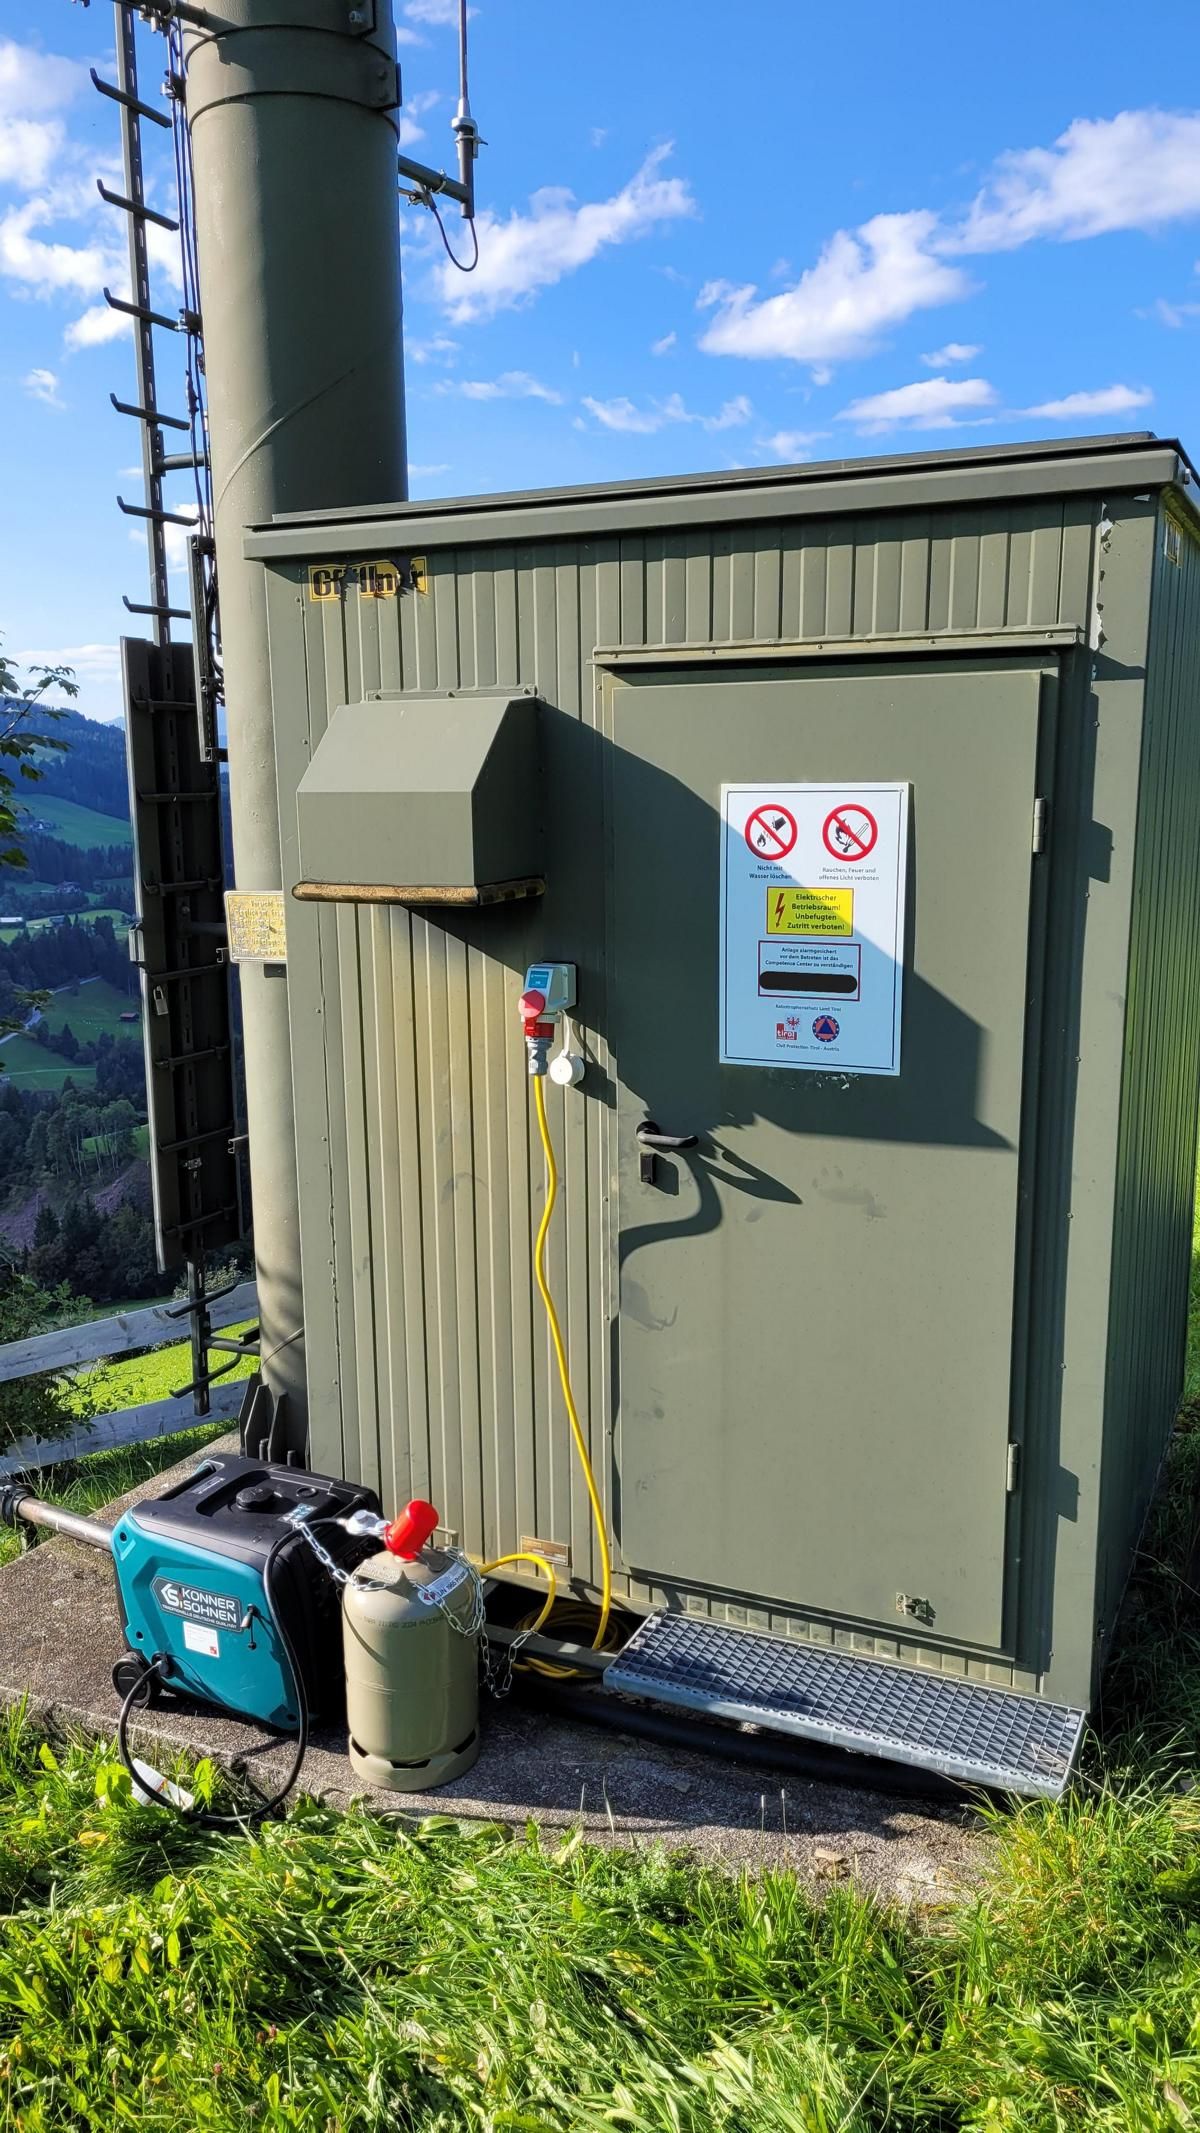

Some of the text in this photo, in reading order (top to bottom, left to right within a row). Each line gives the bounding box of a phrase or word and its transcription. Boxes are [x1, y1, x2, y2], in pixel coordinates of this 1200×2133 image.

[795, 893, 837, 901] Elektrischer
[791, 903, 841, 911] Betriebsraum!
[795, 913, 837, 922] Unbefugten
